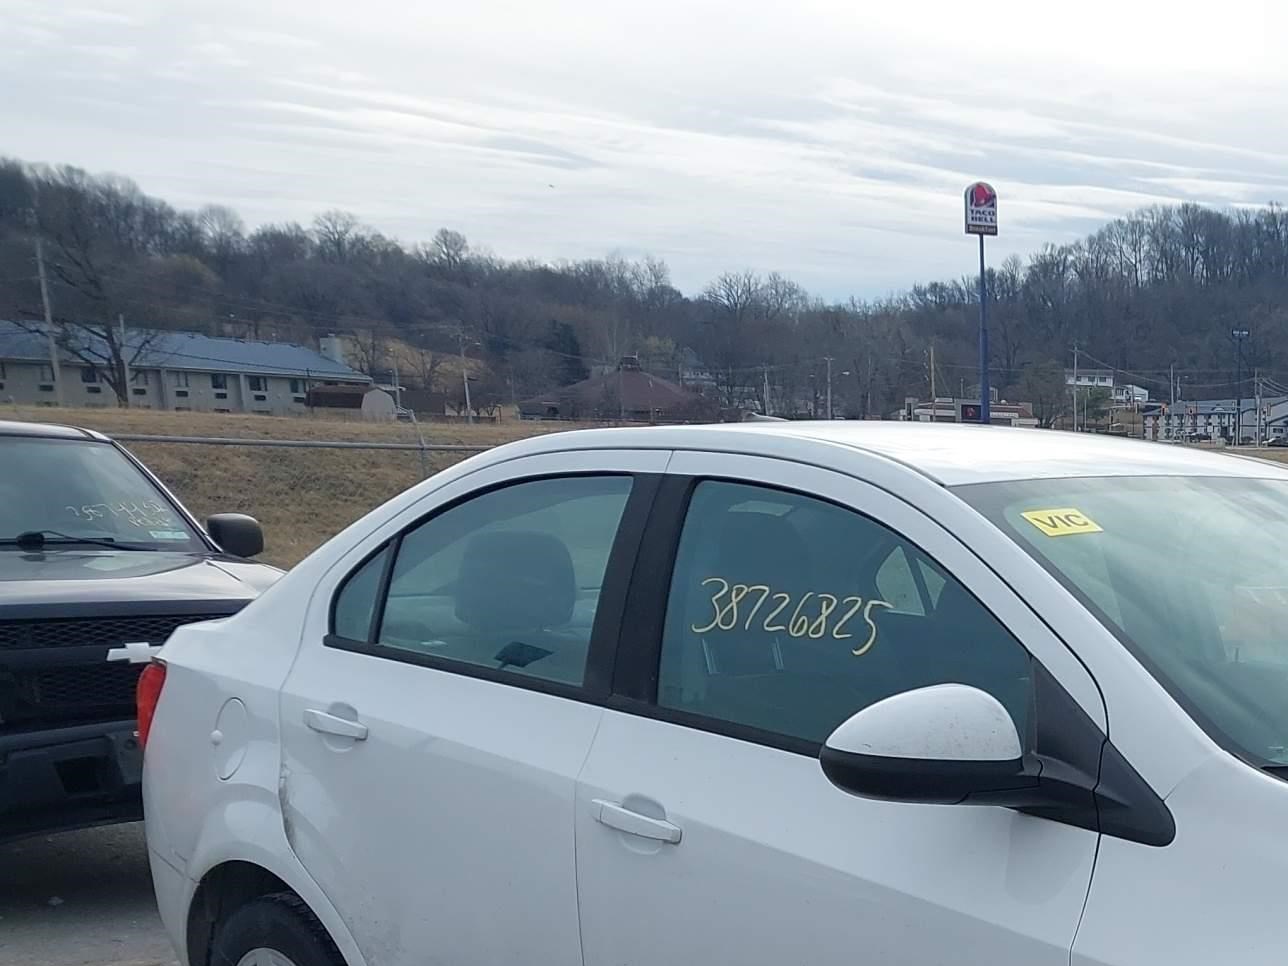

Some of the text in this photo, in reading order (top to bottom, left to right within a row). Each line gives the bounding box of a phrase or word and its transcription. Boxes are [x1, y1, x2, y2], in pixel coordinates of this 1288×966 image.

[970, 209, 995, 217] TACO
[1031, 514, 1089, 529] VIC
[691, 577, 894, 656] 38726825
